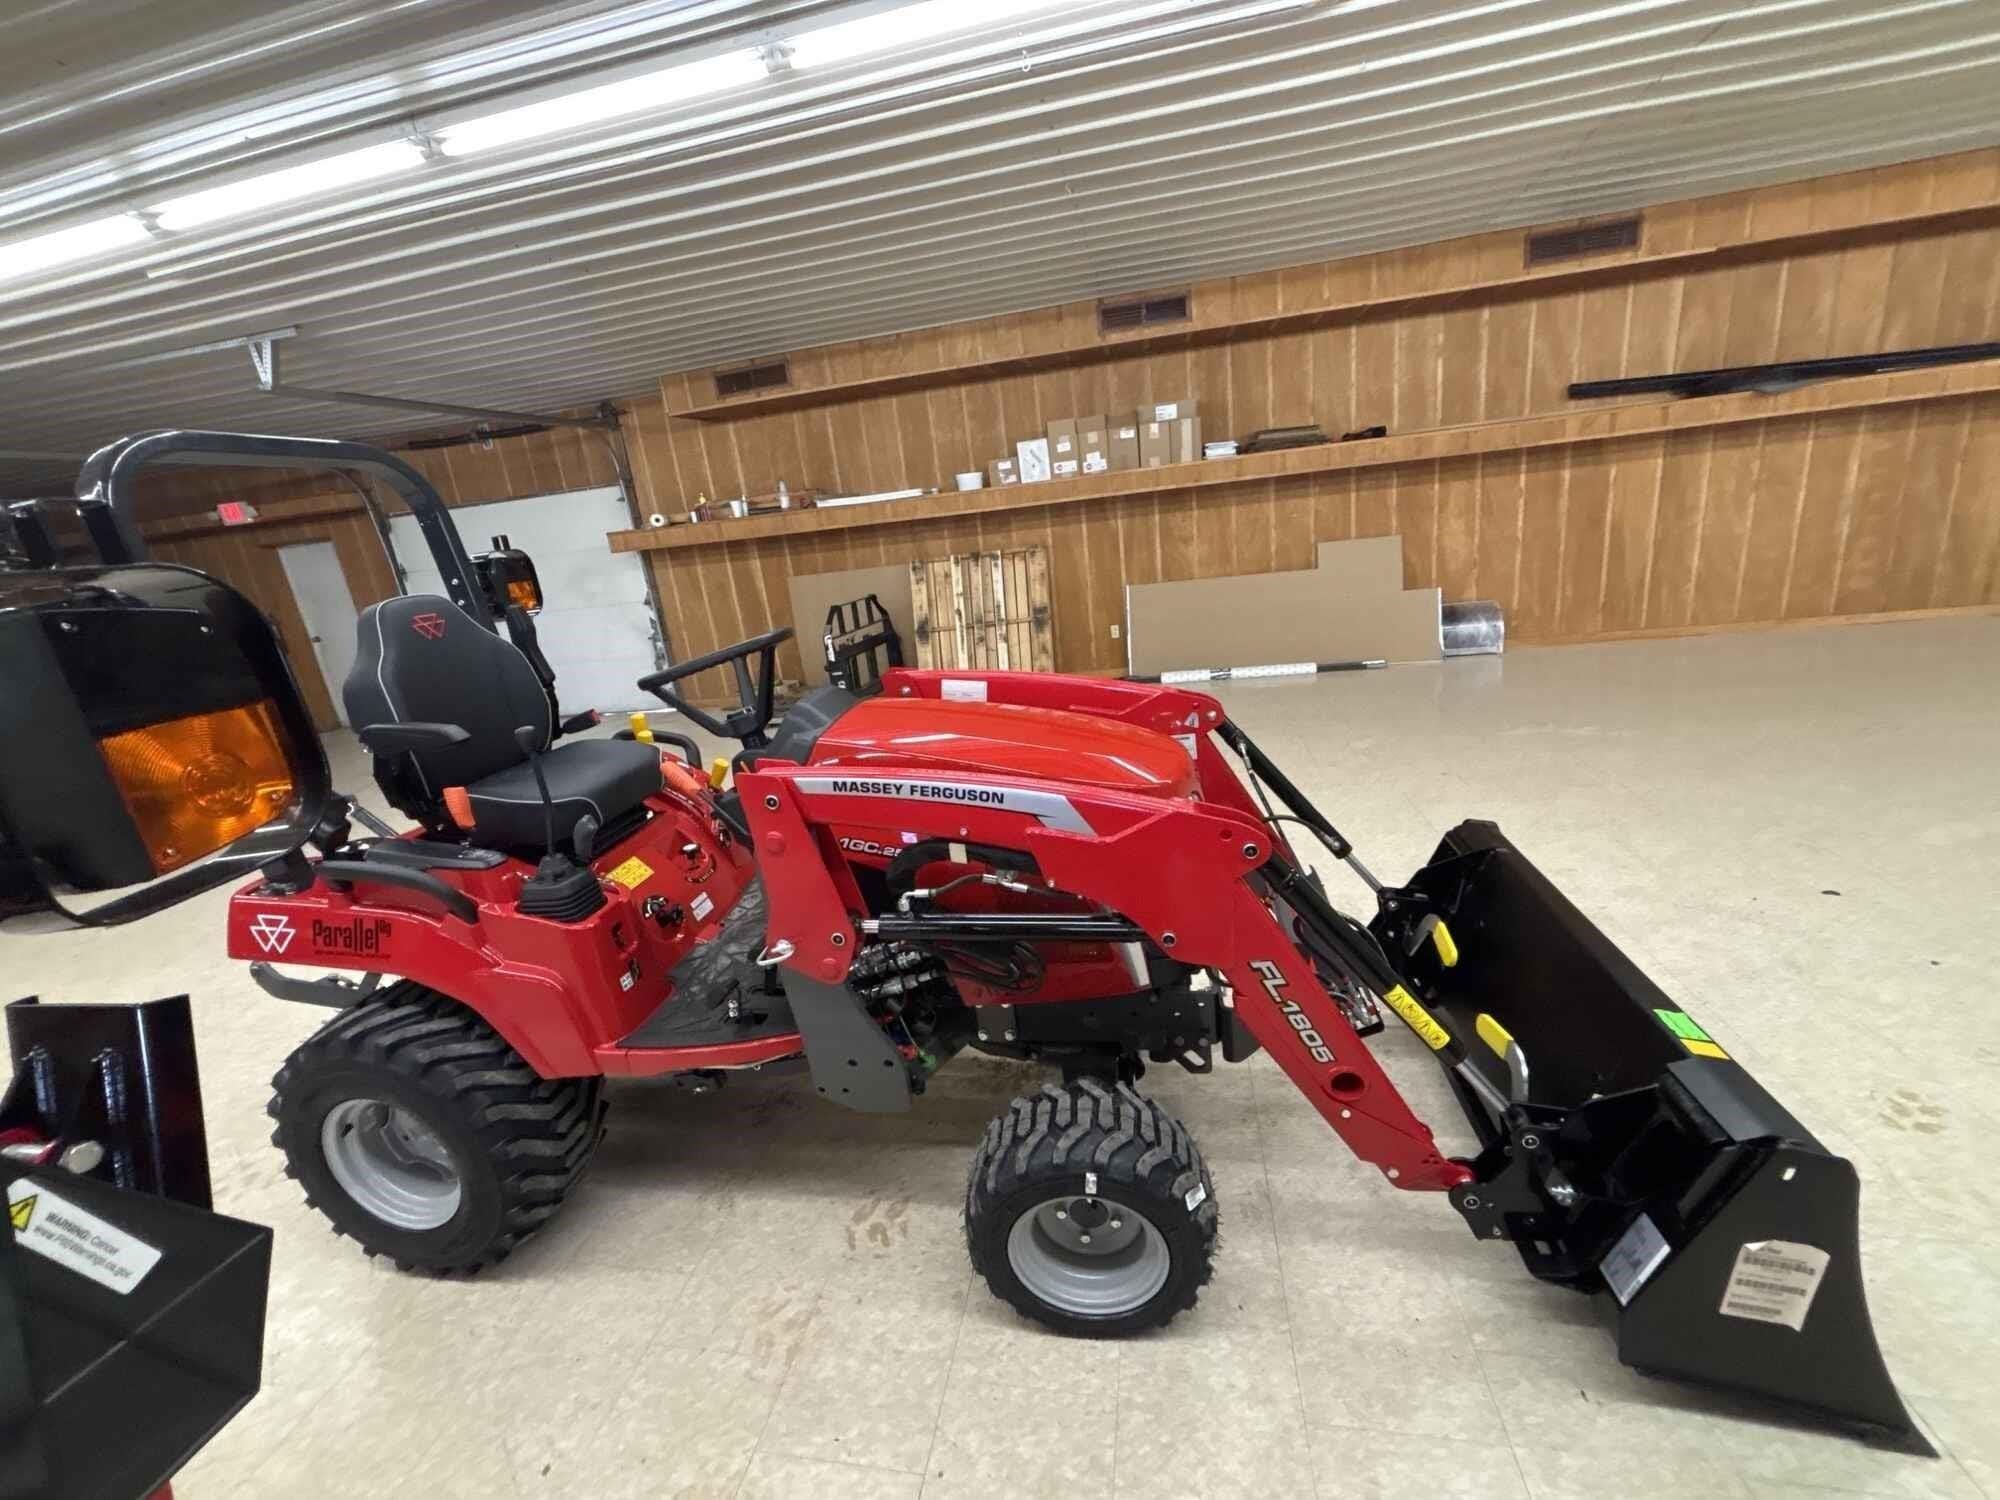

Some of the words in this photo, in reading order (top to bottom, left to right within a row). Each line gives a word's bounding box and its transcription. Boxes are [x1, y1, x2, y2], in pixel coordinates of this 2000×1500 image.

[832, 780, 904, 796] MASSEY
[909, 784, 1005, 804] FERGUSON
[1249, 959, 1336, 1063] FL.1805
